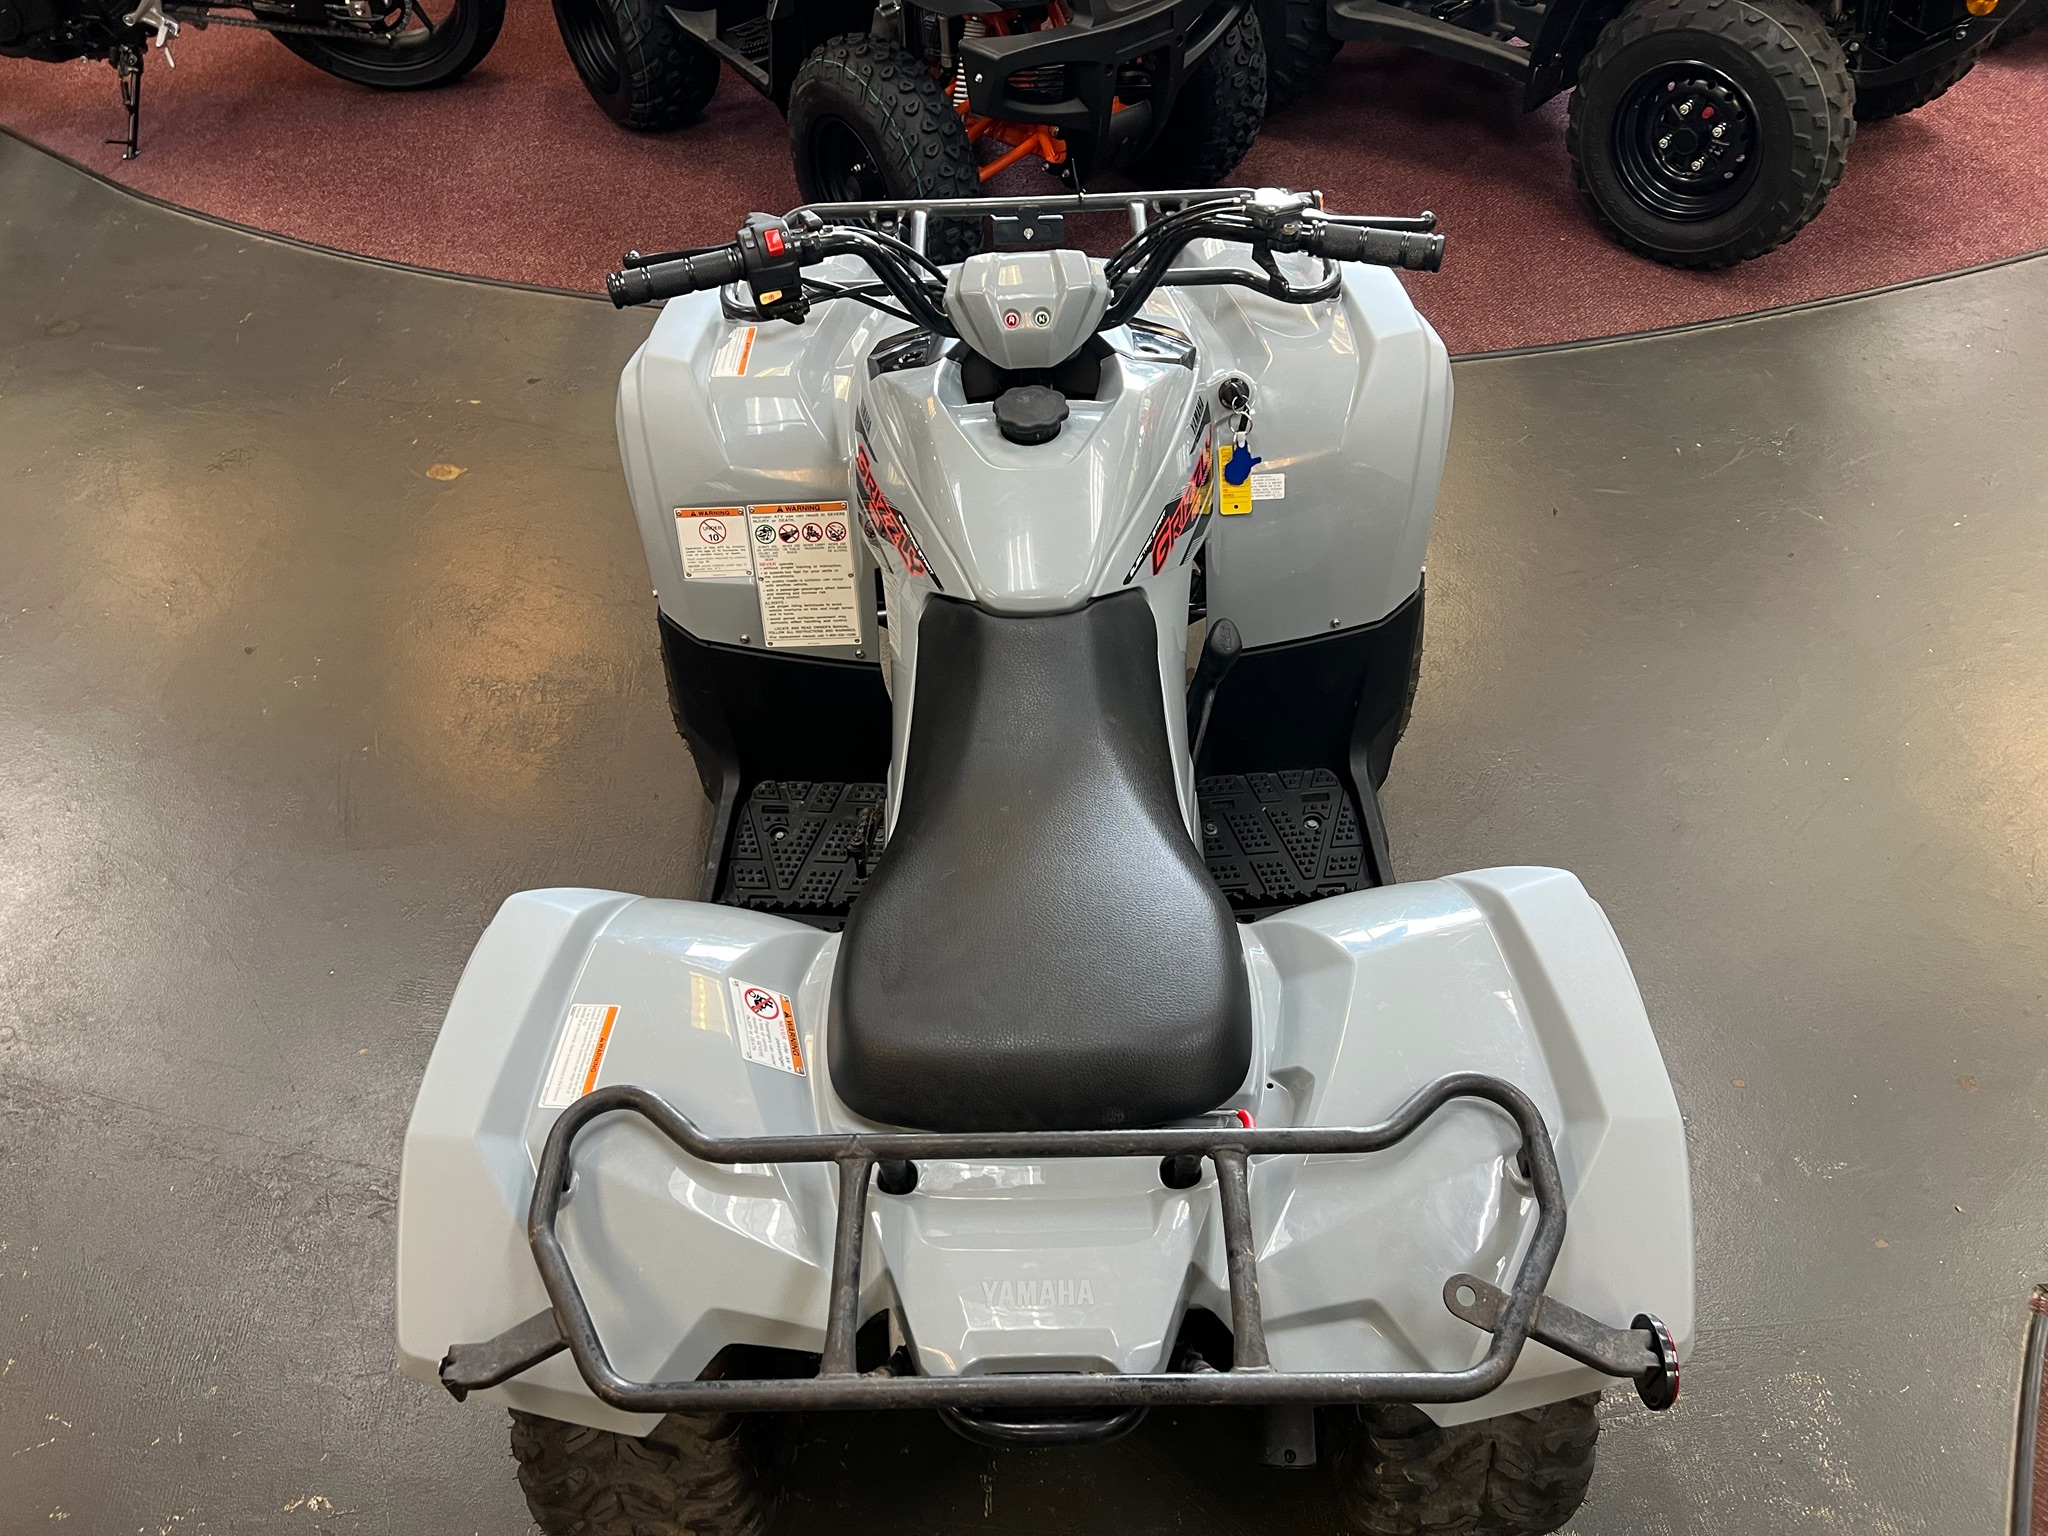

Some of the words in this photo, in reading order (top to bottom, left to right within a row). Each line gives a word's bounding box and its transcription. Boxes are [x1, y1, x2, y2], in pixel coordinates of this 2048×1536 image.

[785, 504, 821, 512] WARNING
[708, 533, 720, 542] 10
[898, 514, 919, 551] ELECTRIC
[917, 549, 934, 575] START
[1129, 535, 1154, 578] ELECTRIC
[1152, 509, 1167, 537] START
[786, 1020, 800, 1056] WARNING
[591, 1042, 605, 1073] WARNING
[981, 1279, 1095, 1307] YAMAHA
